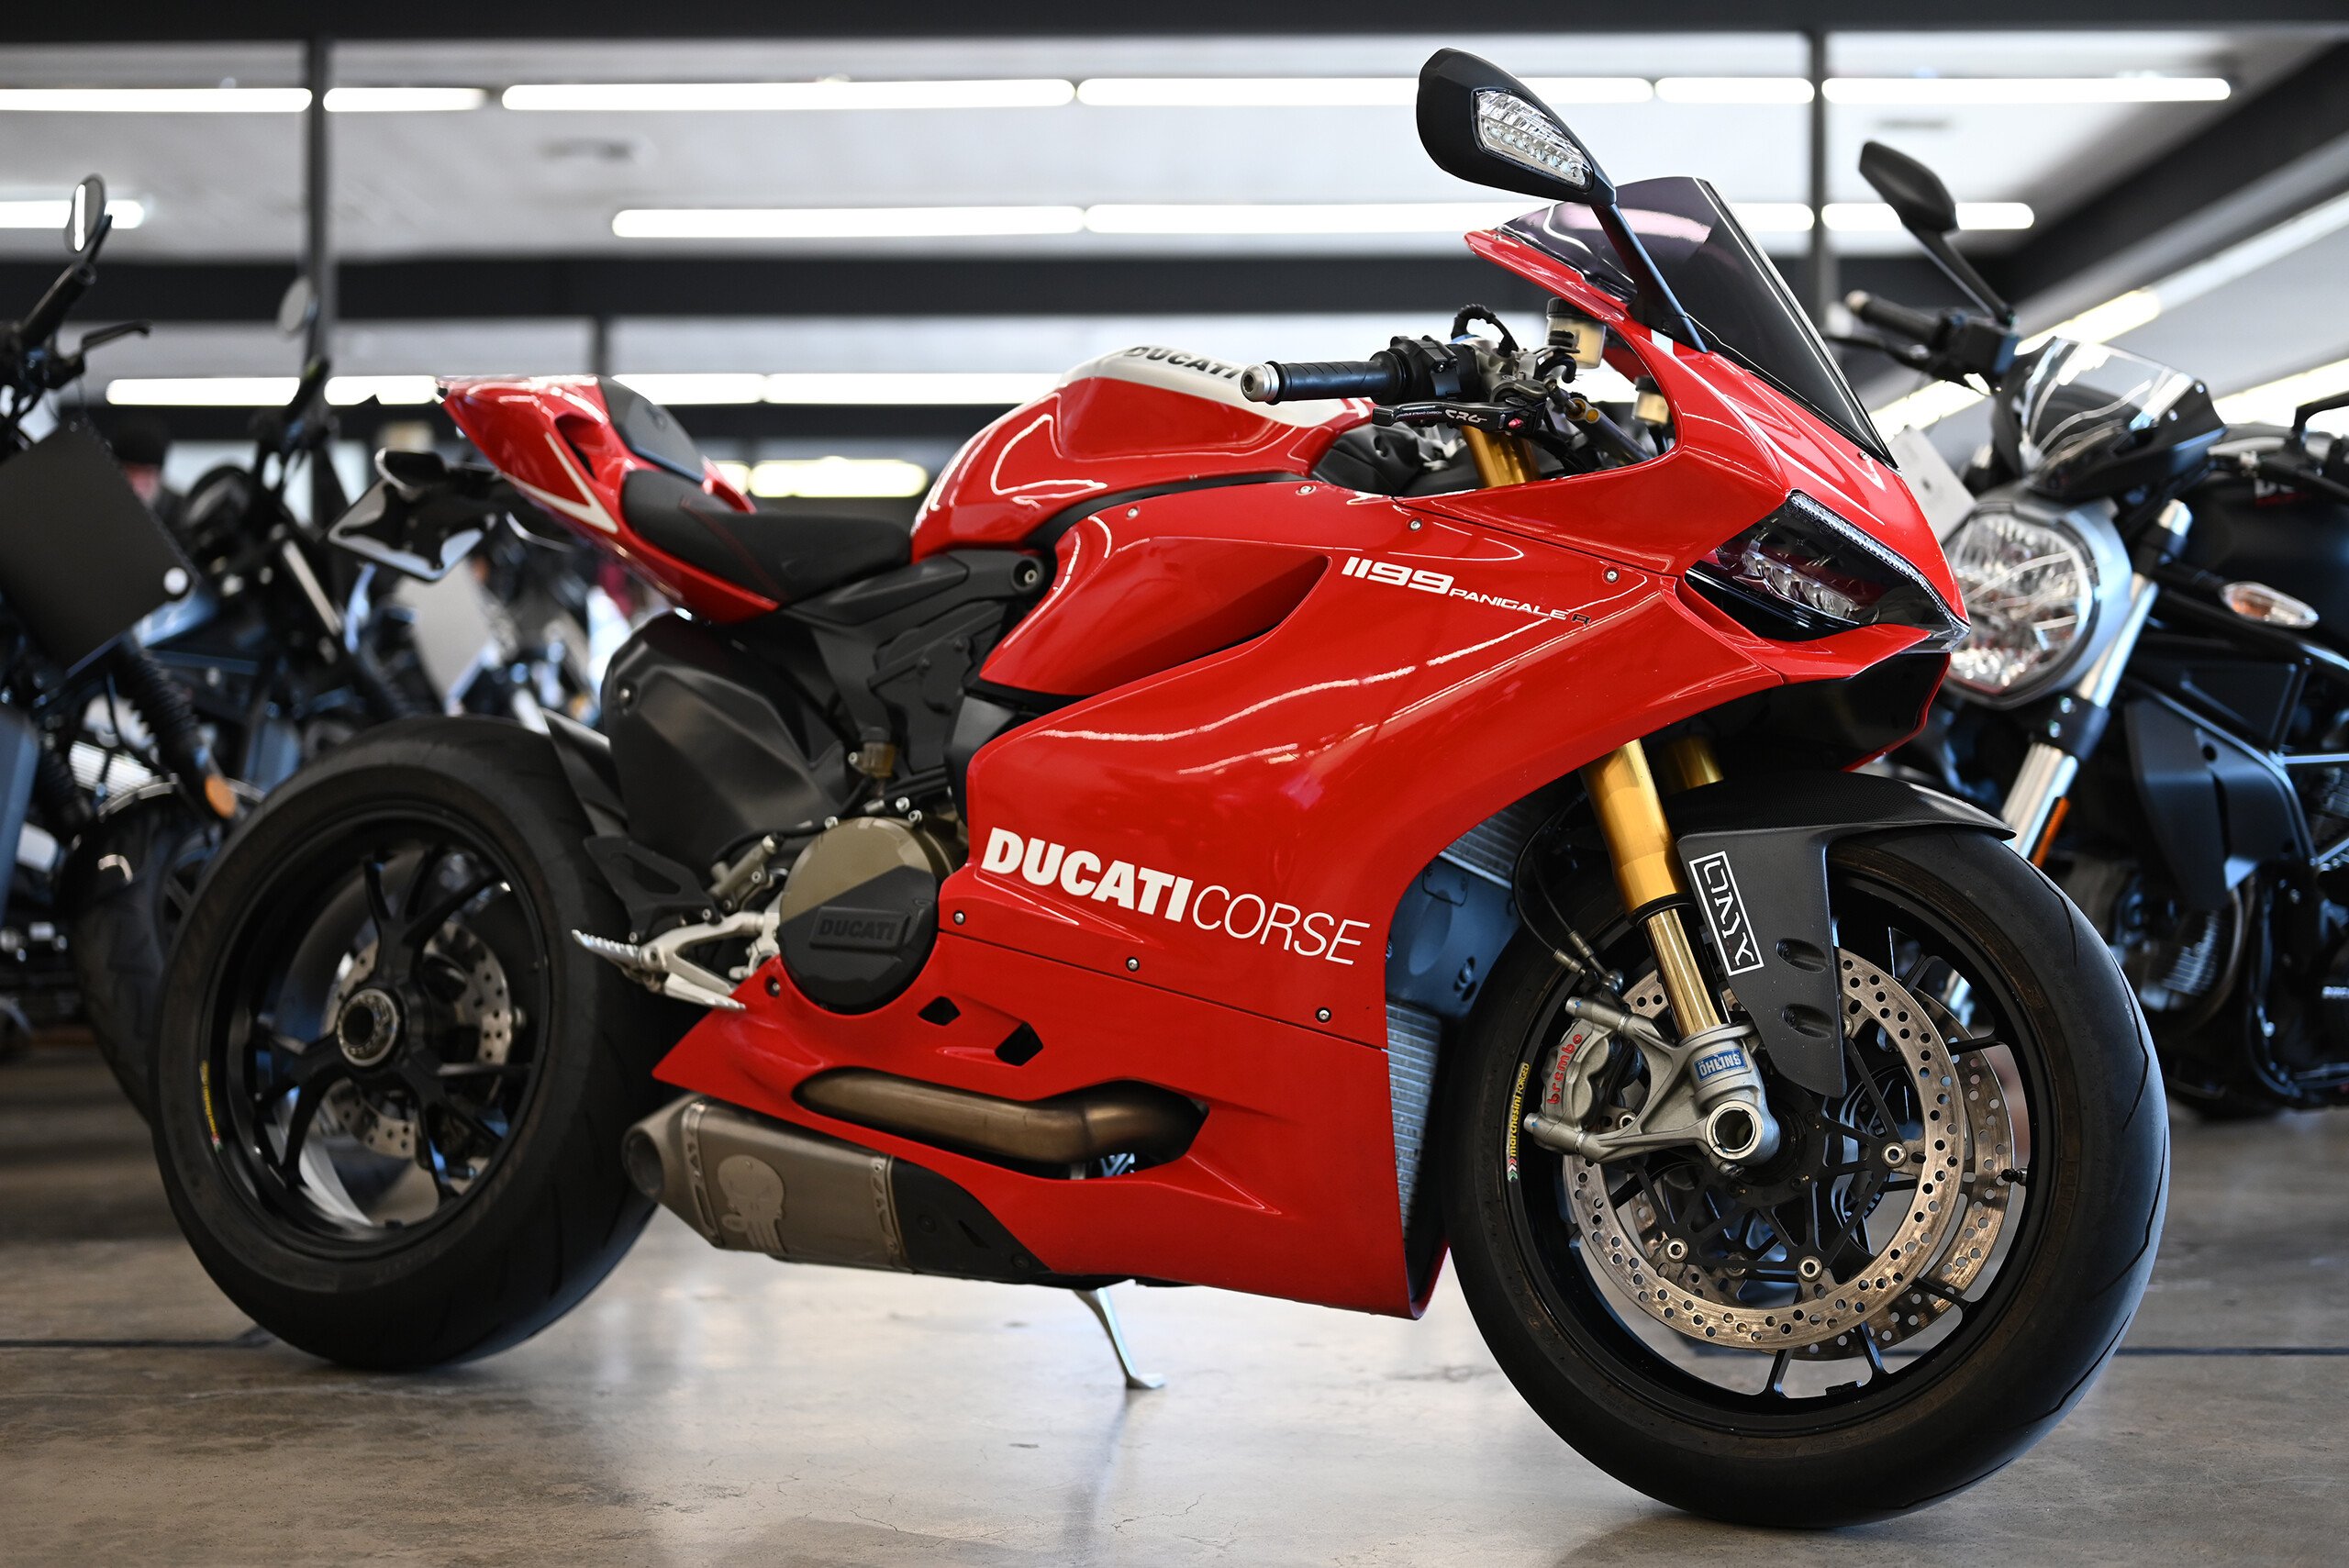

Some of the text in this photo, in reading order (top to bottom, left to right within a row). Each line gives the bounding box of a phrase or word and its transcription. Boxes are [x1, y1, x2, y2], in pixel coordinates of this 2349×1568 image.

[1123, 346, 1242, 379] DUCATI
[1341, 556, 1454, 595] 1199
[1448, 588, 1570, 620] PANIGALE
[980, 826, 1371, 966] DUCATI CORSE
[818, 918, 897, 940] DUCATI
[1547, 1033, 1583, 1106] brembo
[1698, 1052, 1742, 1077] ÖHLINS
[1509, 1062, 1531, 1158] marchesini FORGED
